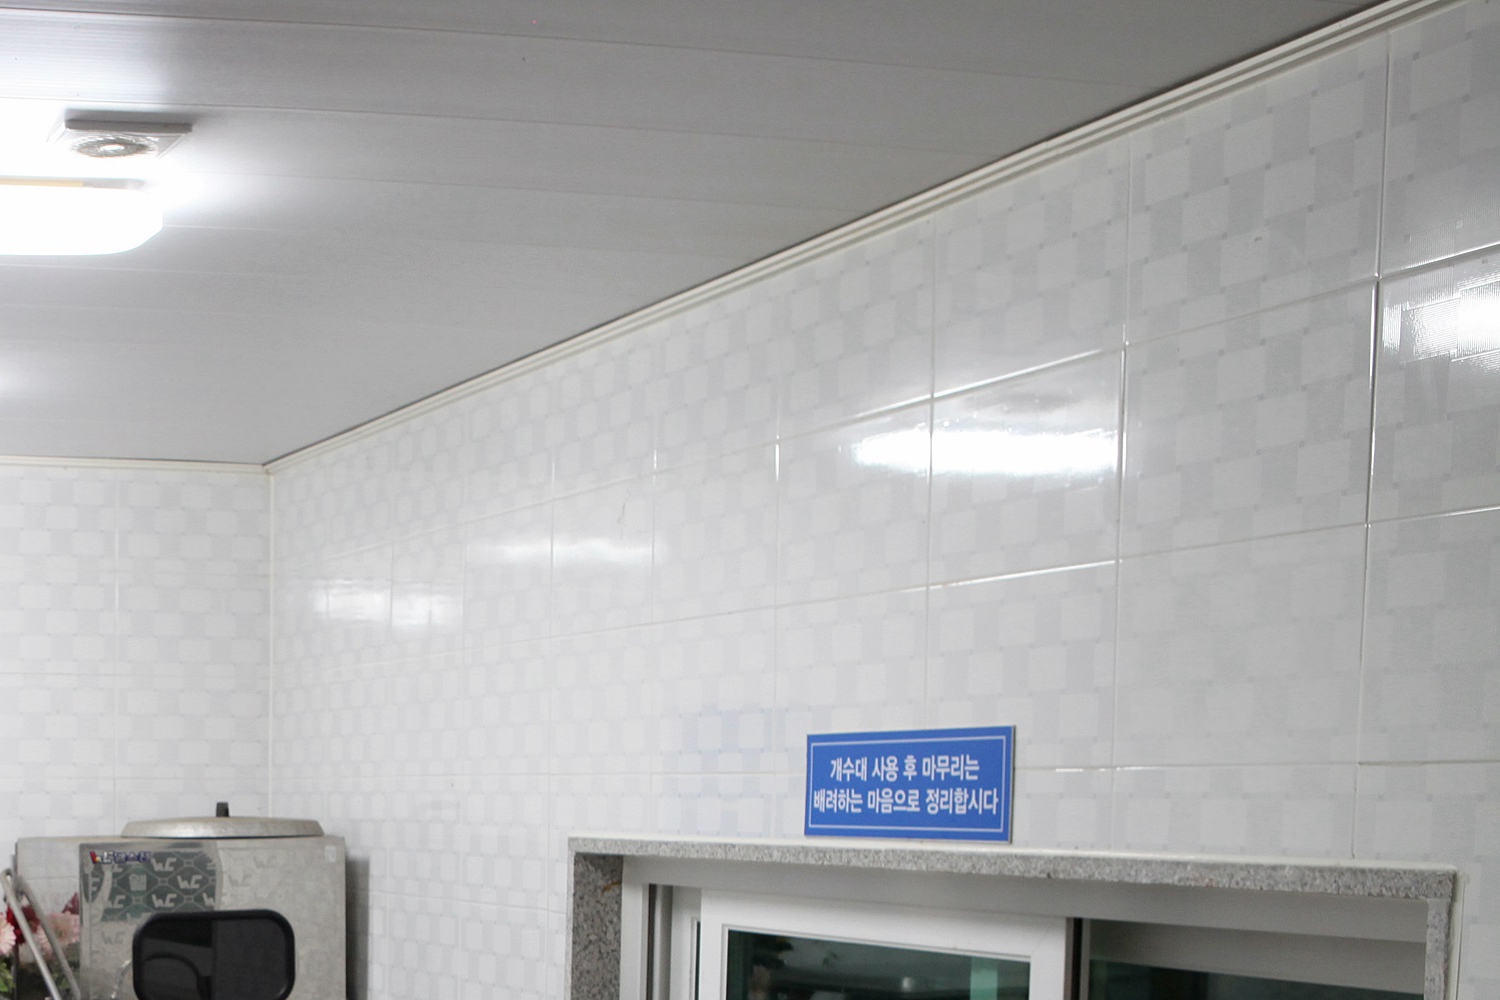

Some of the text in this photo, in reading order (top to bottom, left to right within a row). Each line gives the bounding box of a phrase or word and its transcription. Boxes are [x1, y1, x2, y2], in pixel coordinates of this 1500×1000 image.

[830, 754, 980, 782] 개수대 사용 후 마무리는
[813, 788, 999, 815] 배려하는 마음으로 정리합시다
